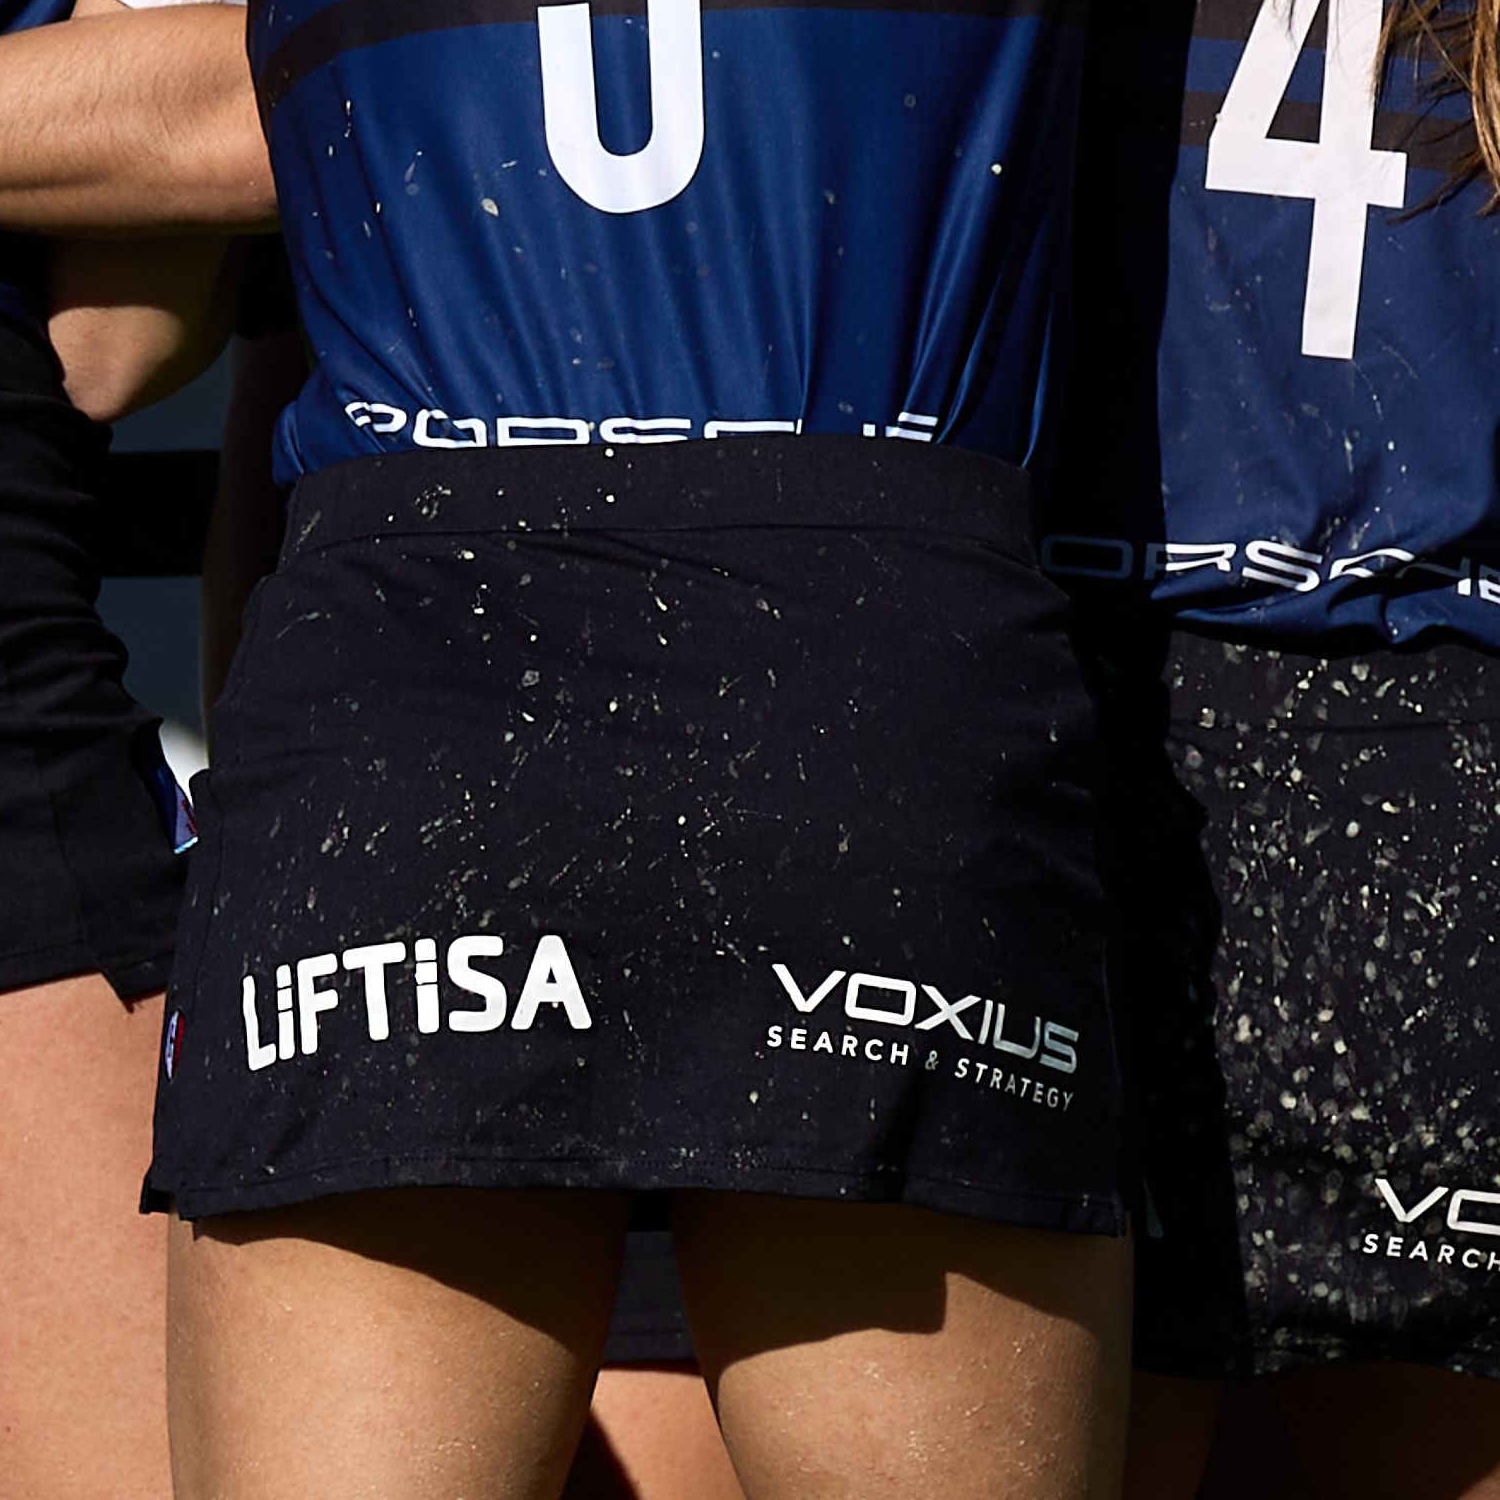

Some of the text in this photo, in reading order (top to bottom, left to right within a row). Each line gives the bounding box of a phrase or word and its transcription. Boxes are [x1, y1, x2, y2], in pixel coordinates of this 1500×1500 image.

[771, 963, 1079, 1074] VOXIUS
[766, 1025, 1075, 1112] SEARCH & STRATEGY
